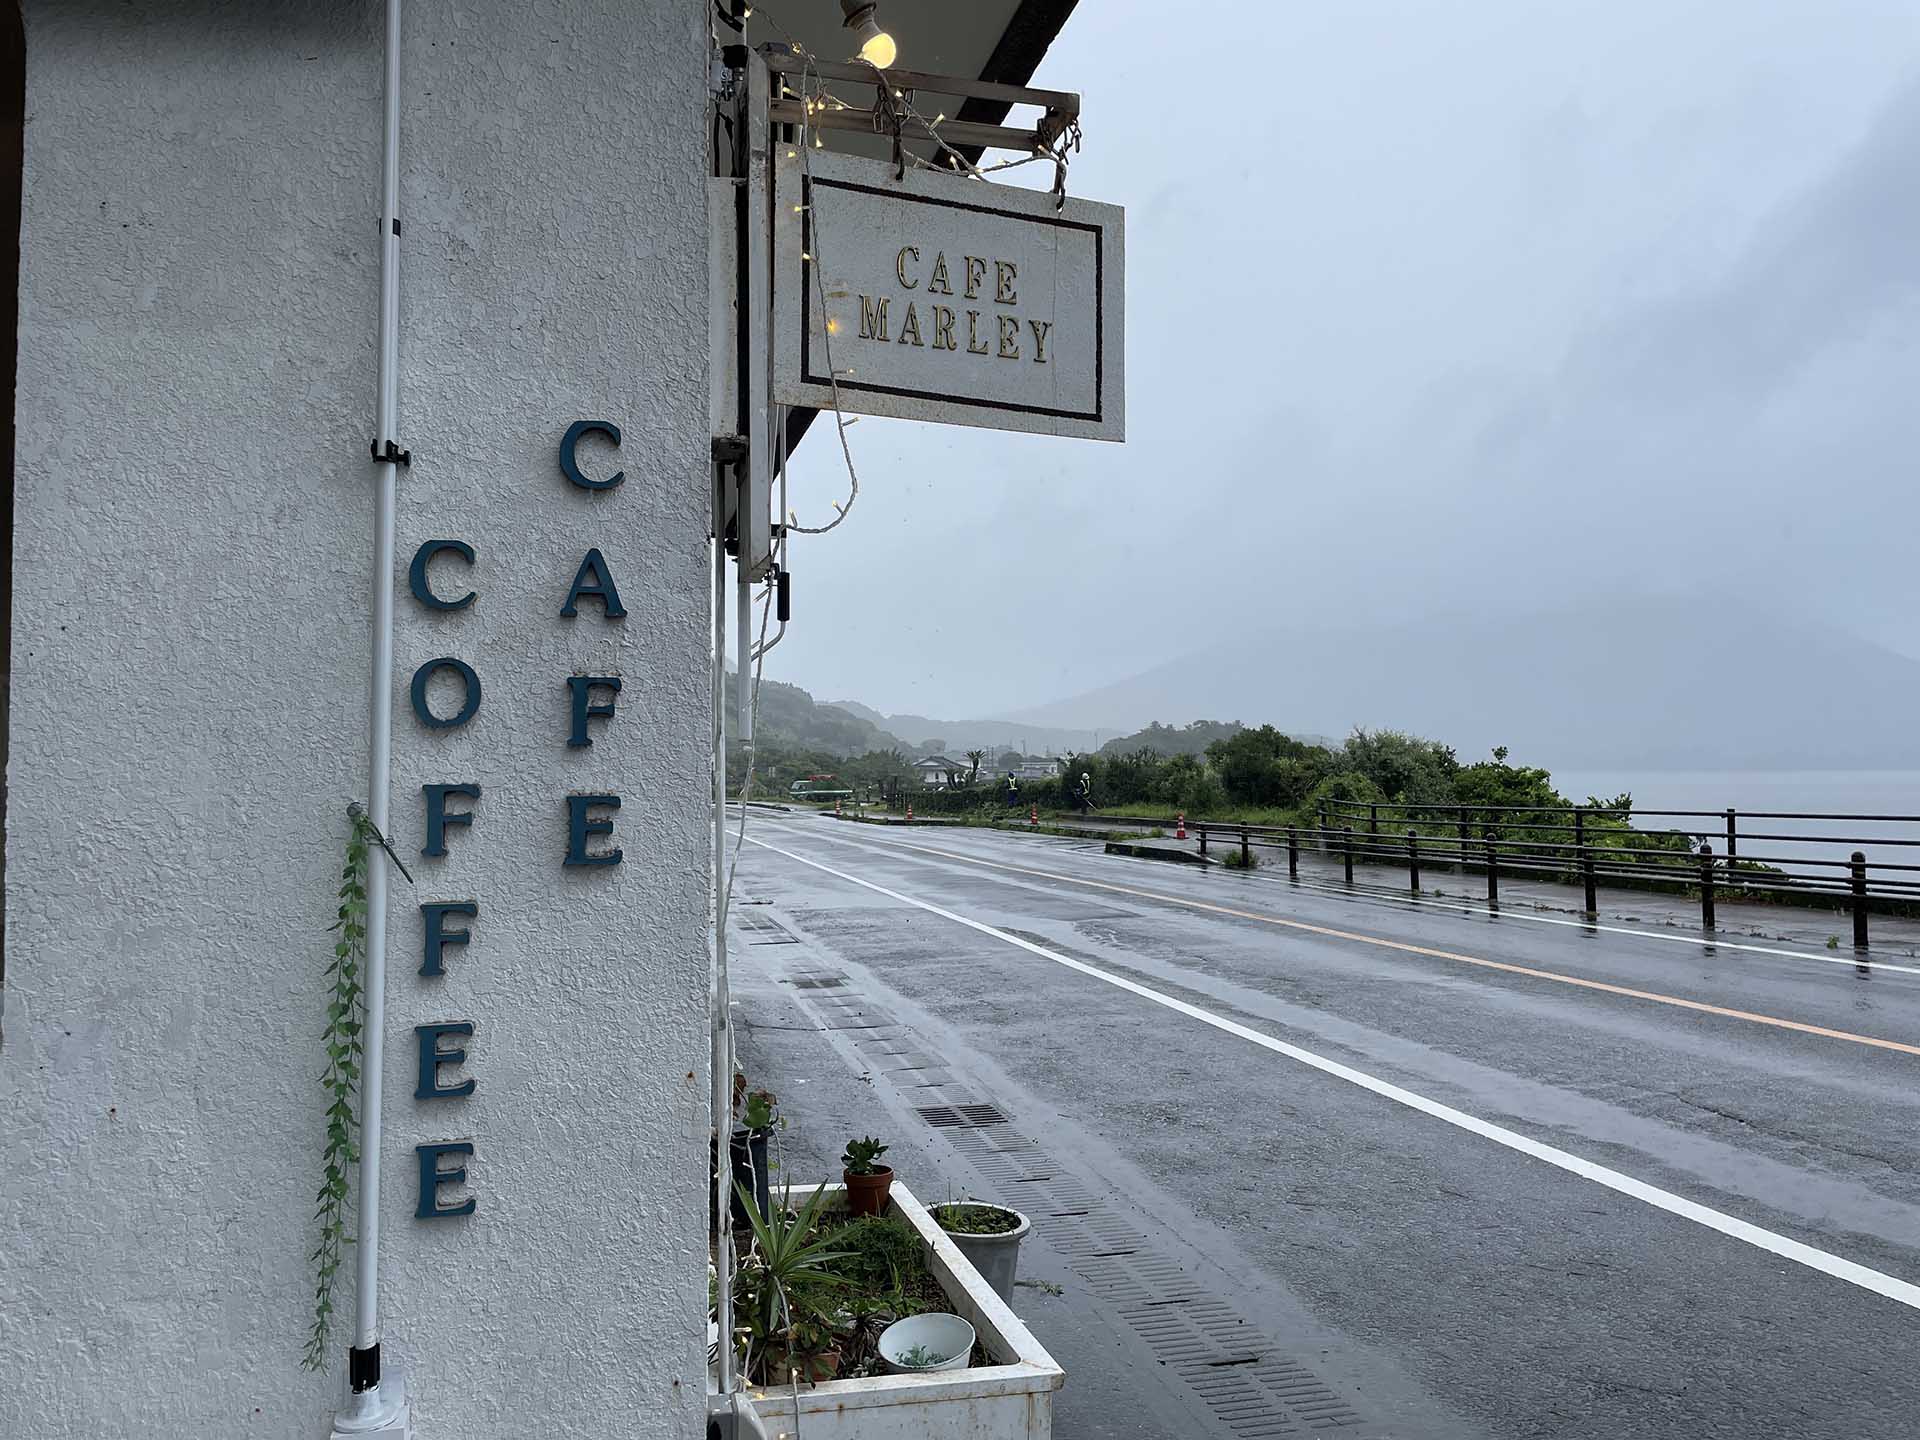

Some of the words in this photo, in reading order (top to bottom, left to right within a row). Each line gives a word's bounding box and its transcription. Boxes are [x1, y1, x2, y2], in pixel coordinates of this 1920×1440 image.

[858, 294, 1053, 364] MARLEY
[896, 245, 1019, 305] CAFE
[559, 420, 628, 866] CAFE
[409, 539, 482, 1219] COFFEE
